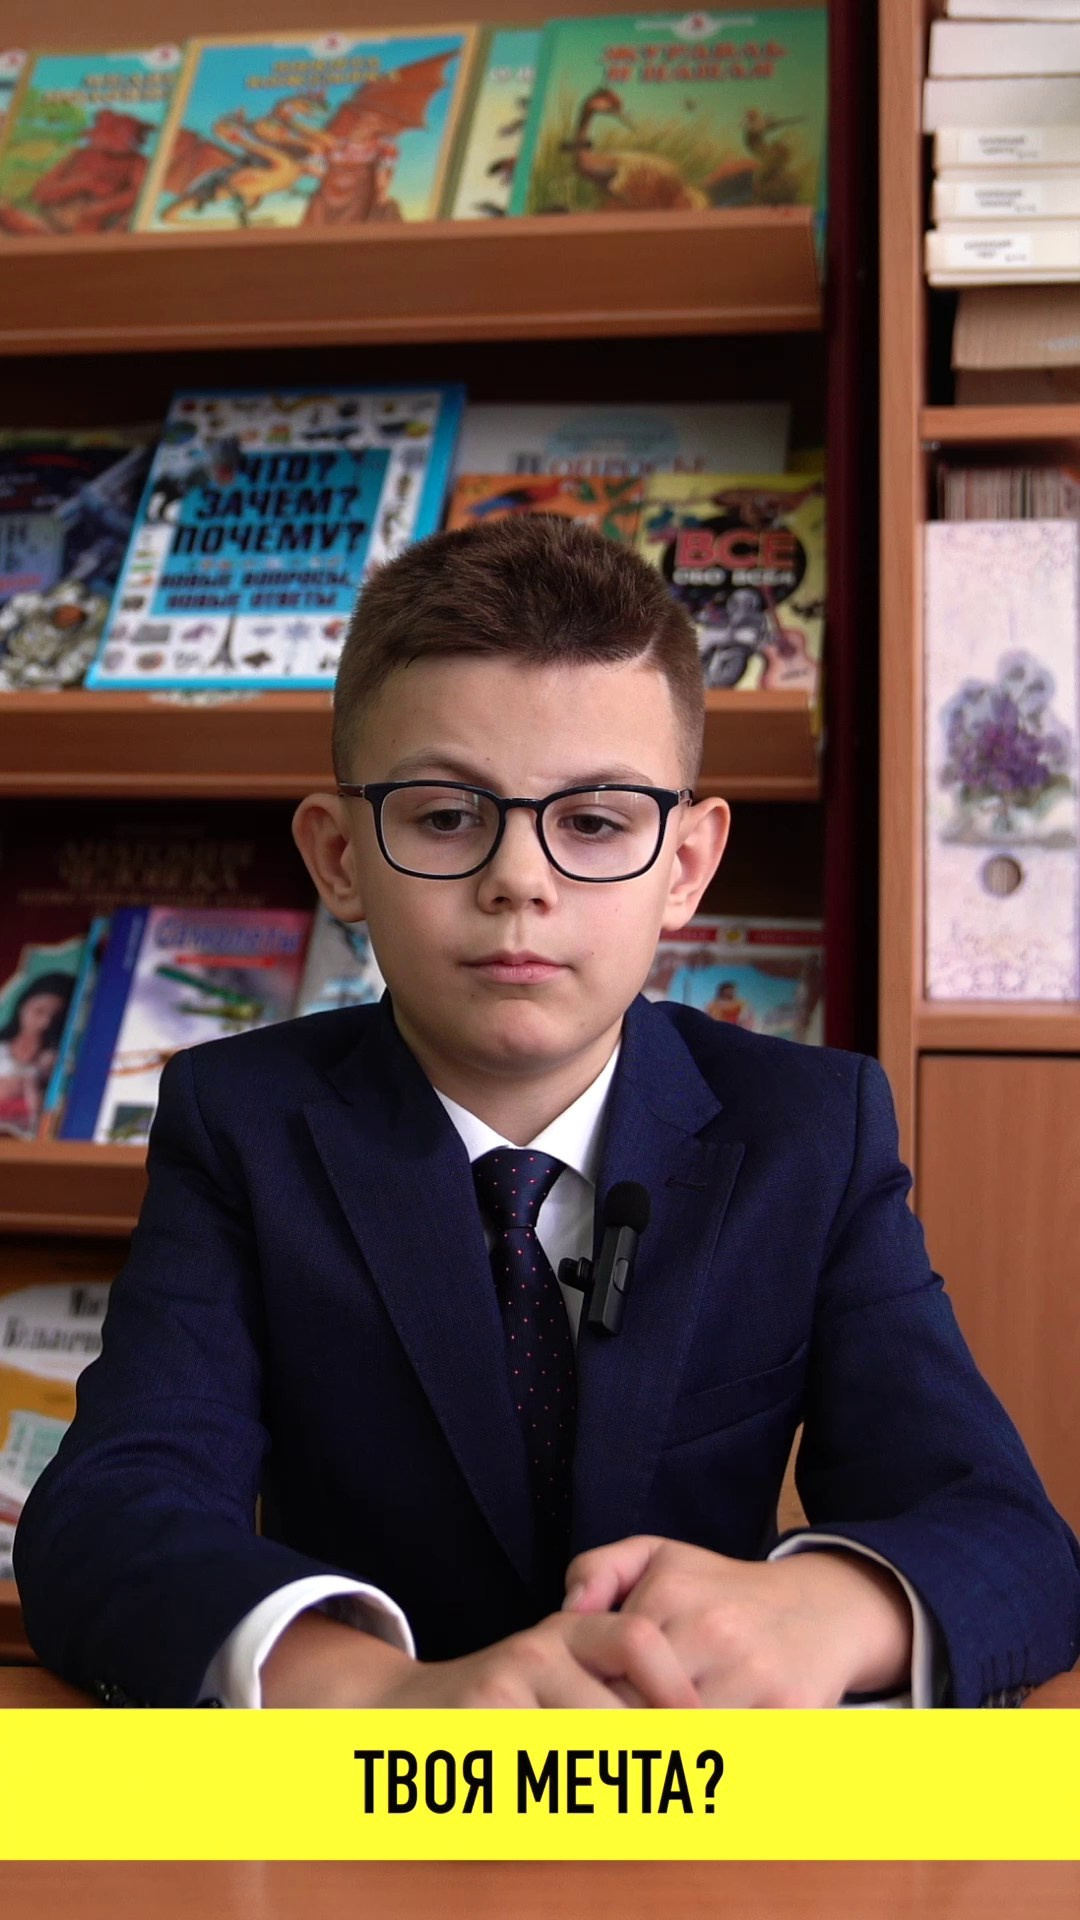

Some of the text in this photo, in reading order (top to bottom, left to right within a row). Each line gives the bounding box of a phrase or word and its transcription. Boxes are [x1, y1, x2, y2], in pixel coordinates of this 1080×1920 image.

[603, 41, 789, 64] ЖУРАВЛЬ
[234, 452, 337, 485] ЧТО?
[195, 487, 361, 519] ЗАЧЕМ?
[172, 522, 368, 556] ПОЧЕМУ?
[674, 527, 798, 570] ВСЕ
